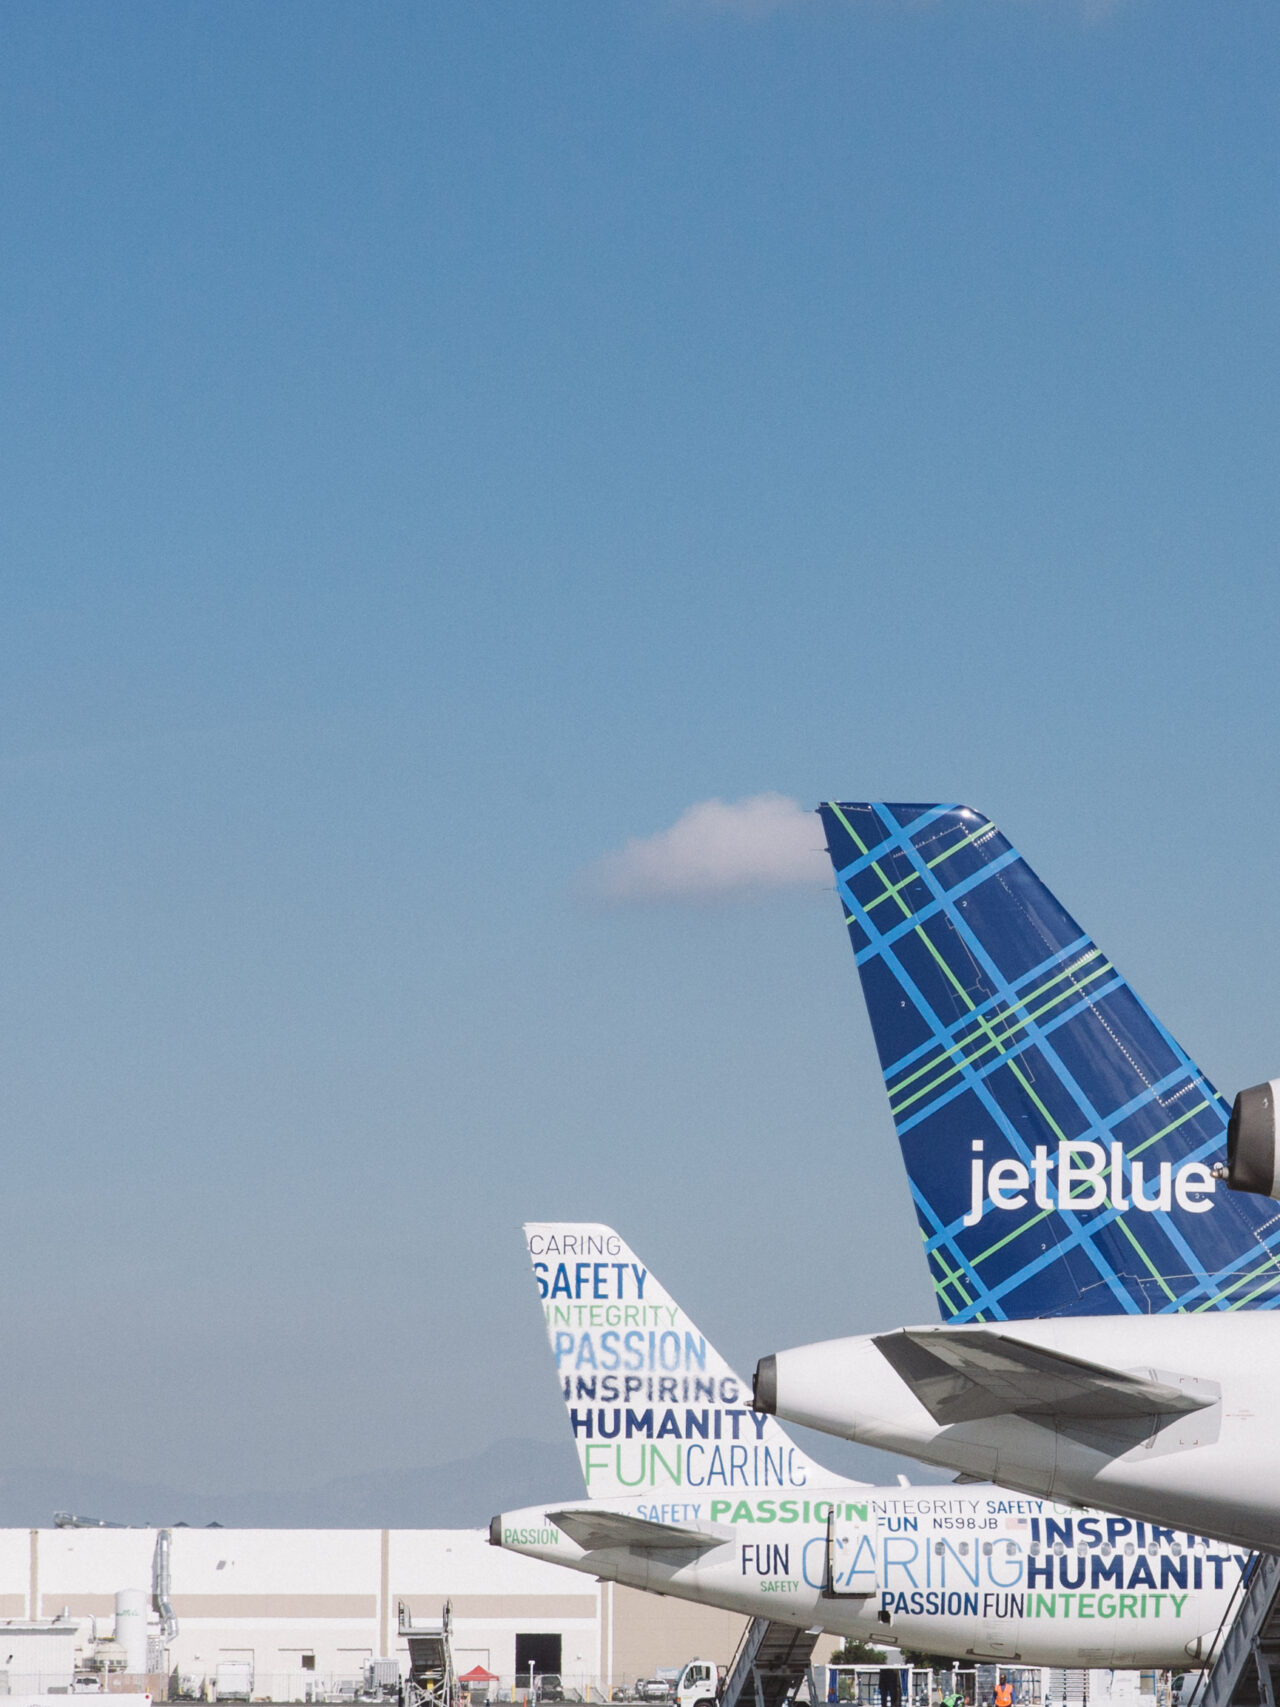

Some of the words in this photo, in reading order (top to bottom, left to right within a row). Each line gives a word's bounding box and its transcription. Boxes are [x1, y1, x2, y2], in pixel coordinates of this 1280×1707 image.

[529, 1234, 621, 1256] CARING
[534, 1261, 647, 1300] SAFETY
[546, 1304, 679, 1327] INTEGRITY
[555, 1330, 707, 1371] PASSION
[563, 1374, 740, 1404] INSPIRING
[570, 1408, 768, 1440] HUMANITY
[585, 1443, 682, 1487] FUN
[686, 1444, 807, 1487] CARING
[637, 1504, 702, 1523] SAFETY
[710, 1500, 869, 1524] PASSION
[872, 1500, 980, 1515] NTEGRITY
[986, 1500, 1043, 1514] SAFETY
[932, 1517, 998, 1530] N598JB
[504, 1528, 559, 1545] PASSION
[742, 1543, 790, 1576] FUN
[802, 1534, 1024, 1590] CARING
[1027, 1553, 1258, 1590] HUMANITY
[760, 1580, 800, 1593] SAFETY
[881, 1591, 979, 1616] PASSION
[983, 1592, 1024, 1619] FUN
[1026, 1593, 1188, 1619] INTEGRITY
